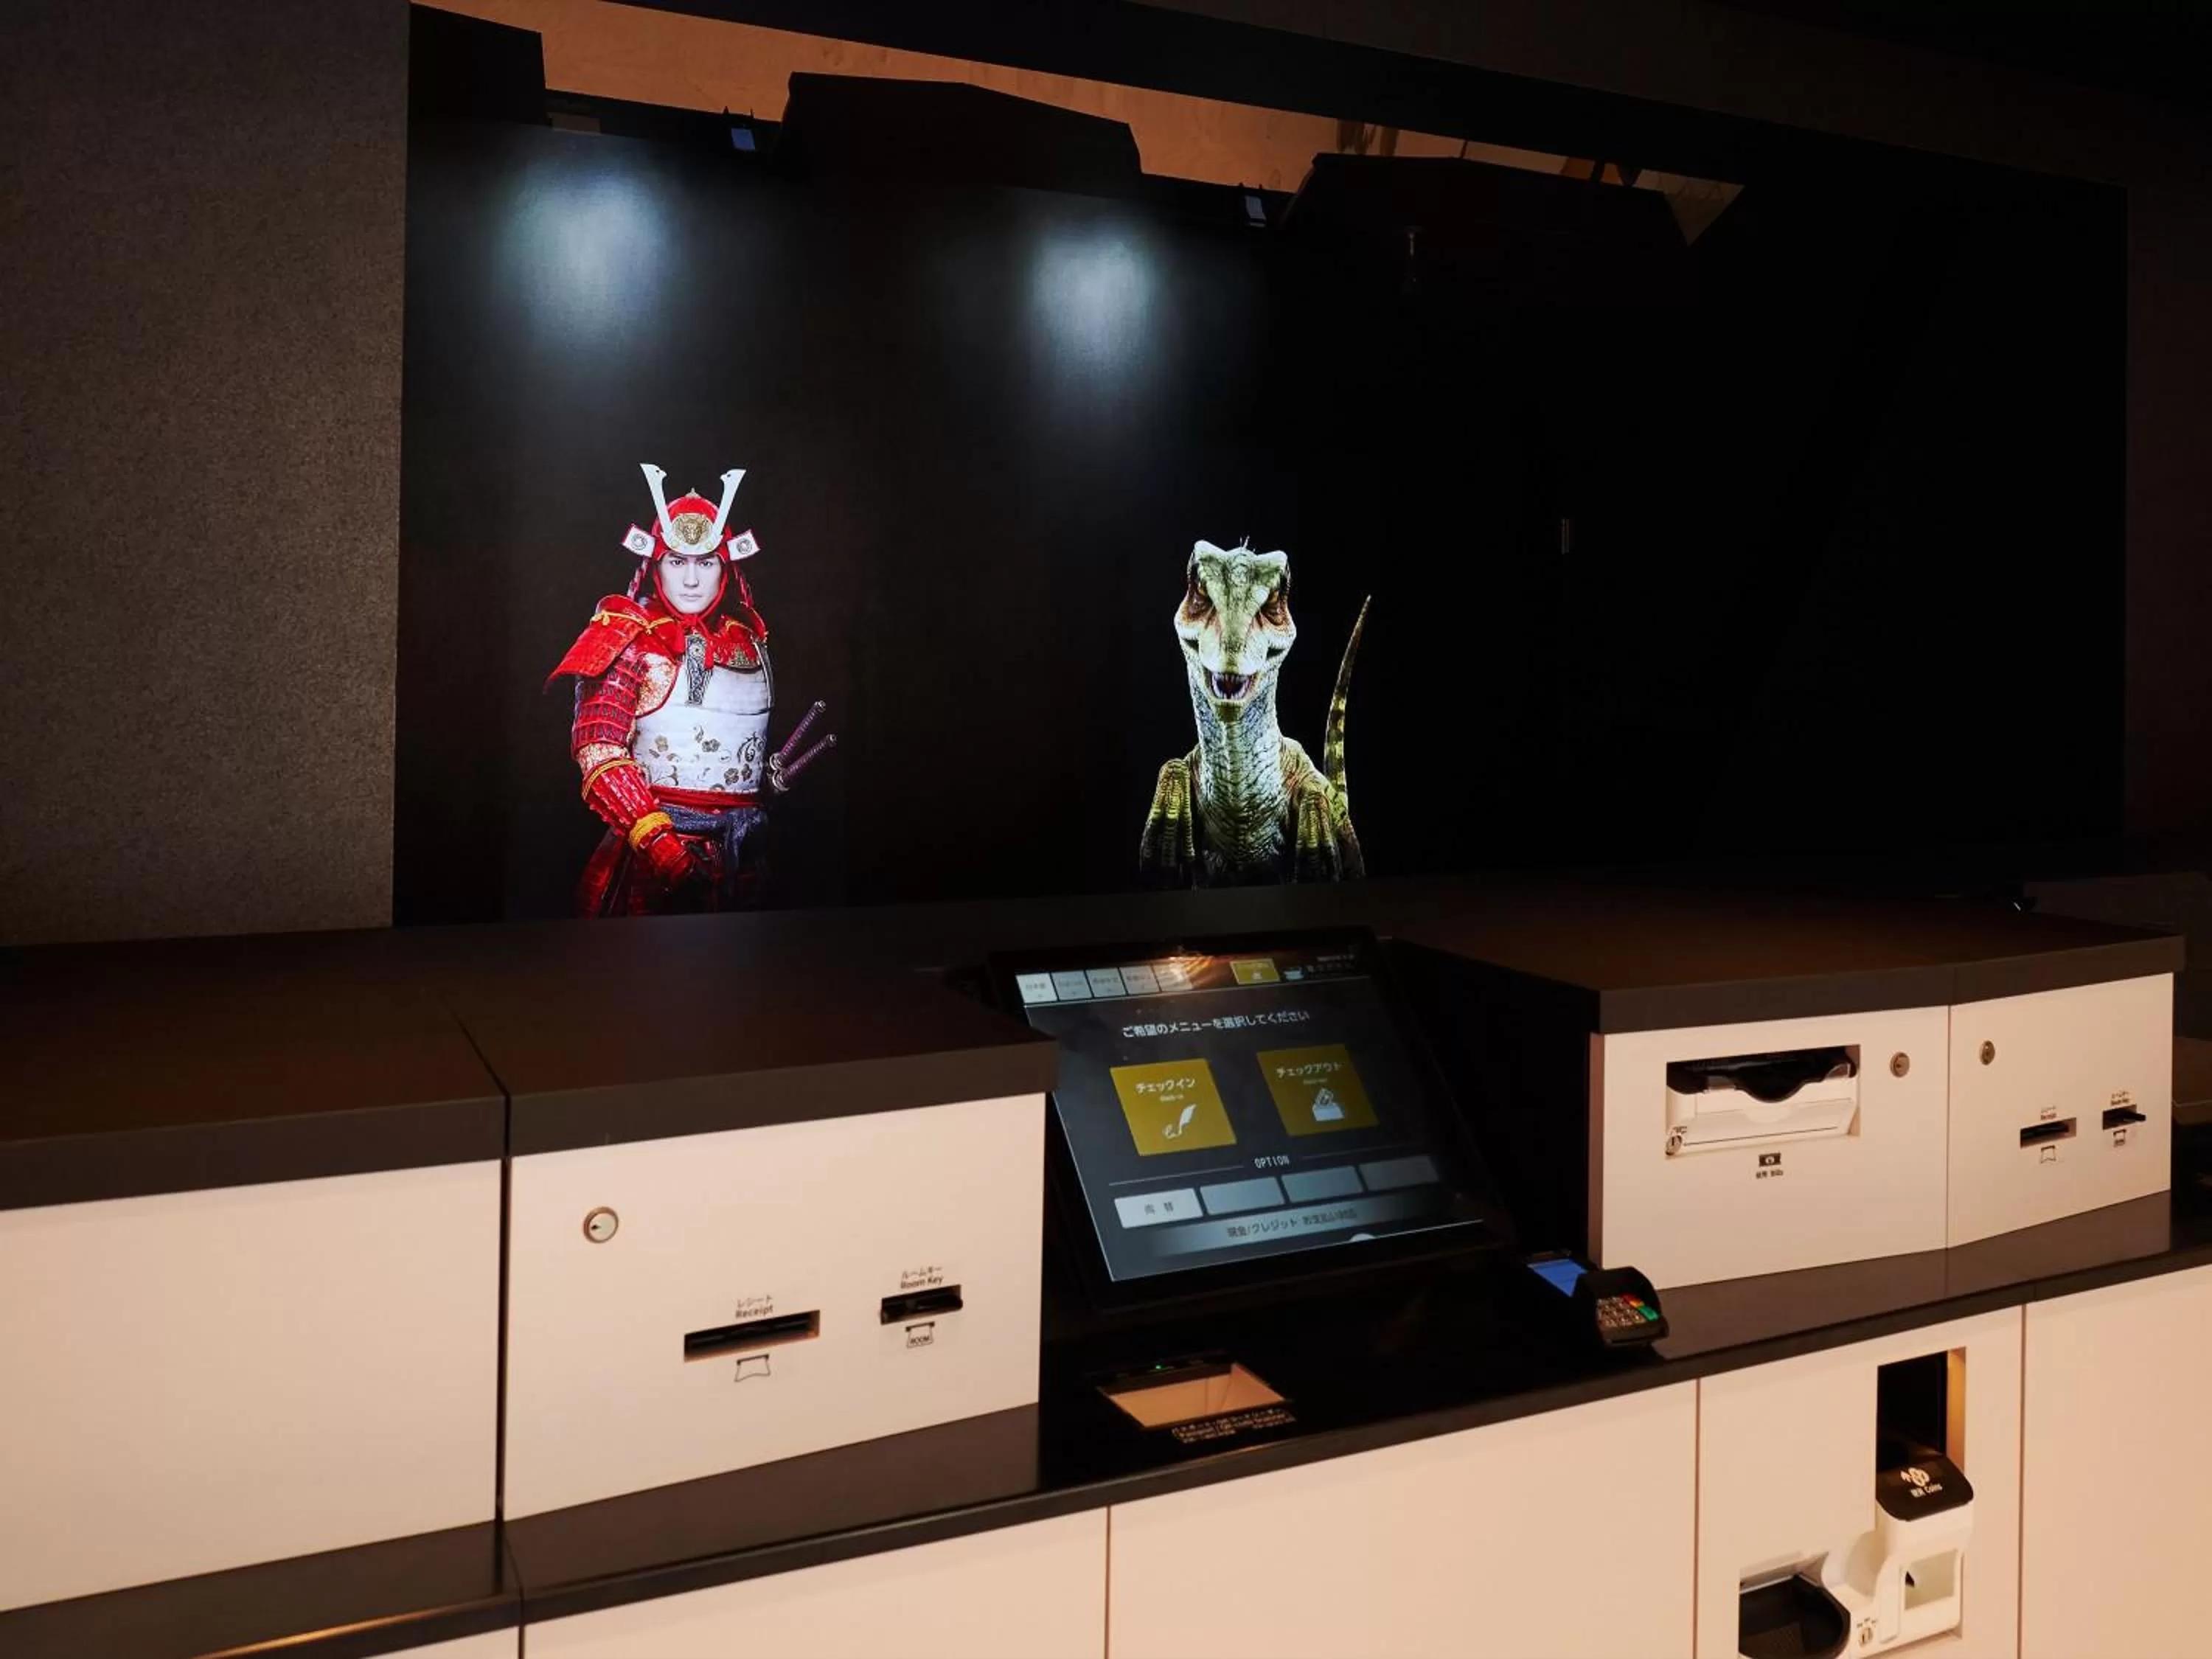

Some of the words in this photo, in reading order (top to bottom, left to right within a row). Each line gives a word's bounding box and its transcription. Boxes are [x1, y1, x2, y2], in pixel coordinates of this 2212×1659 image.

[1121, 1009, 1310, 1038] ご希望のメニューを選択してください
[1276, 1062, 1343, 1079] チェックアウト
[1135, 1078, 1196, 1095] チェックイン
[1253, 1155, 1290, 1169] OPTION
[928, 1275, 944, 1286] Key
[736, 1304, 773, 1319] Receipt
